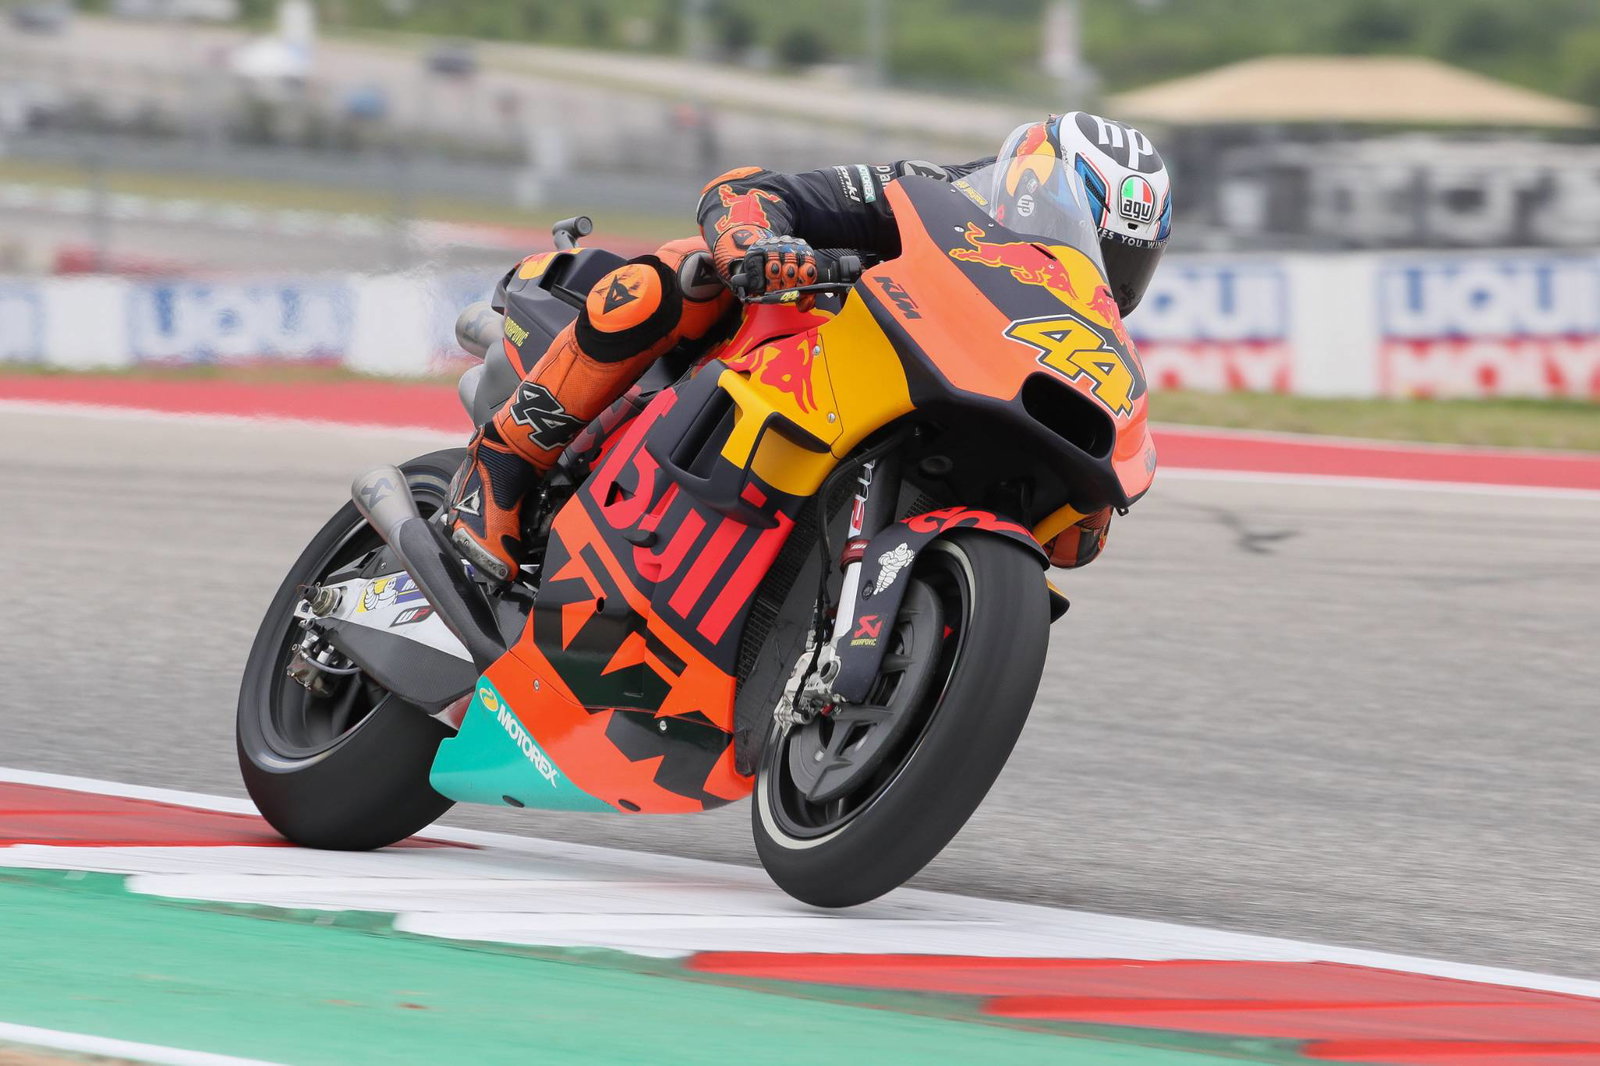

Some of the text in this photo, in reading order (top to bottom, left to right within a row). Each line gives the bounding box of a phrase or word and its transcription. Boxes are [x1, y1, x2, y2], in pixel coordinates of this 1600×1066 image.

[1089, 114, 1154, 170] hp
[1016, 198, 1032, 213] hp
[1121, 235, 1143, 248] YOU
[872, 276, 922, 320] KTM
[1001, 313, 1135, 420] 44
[509, 380, 588, 451] 44
[496, 703, 558, 789] MOTOREX
